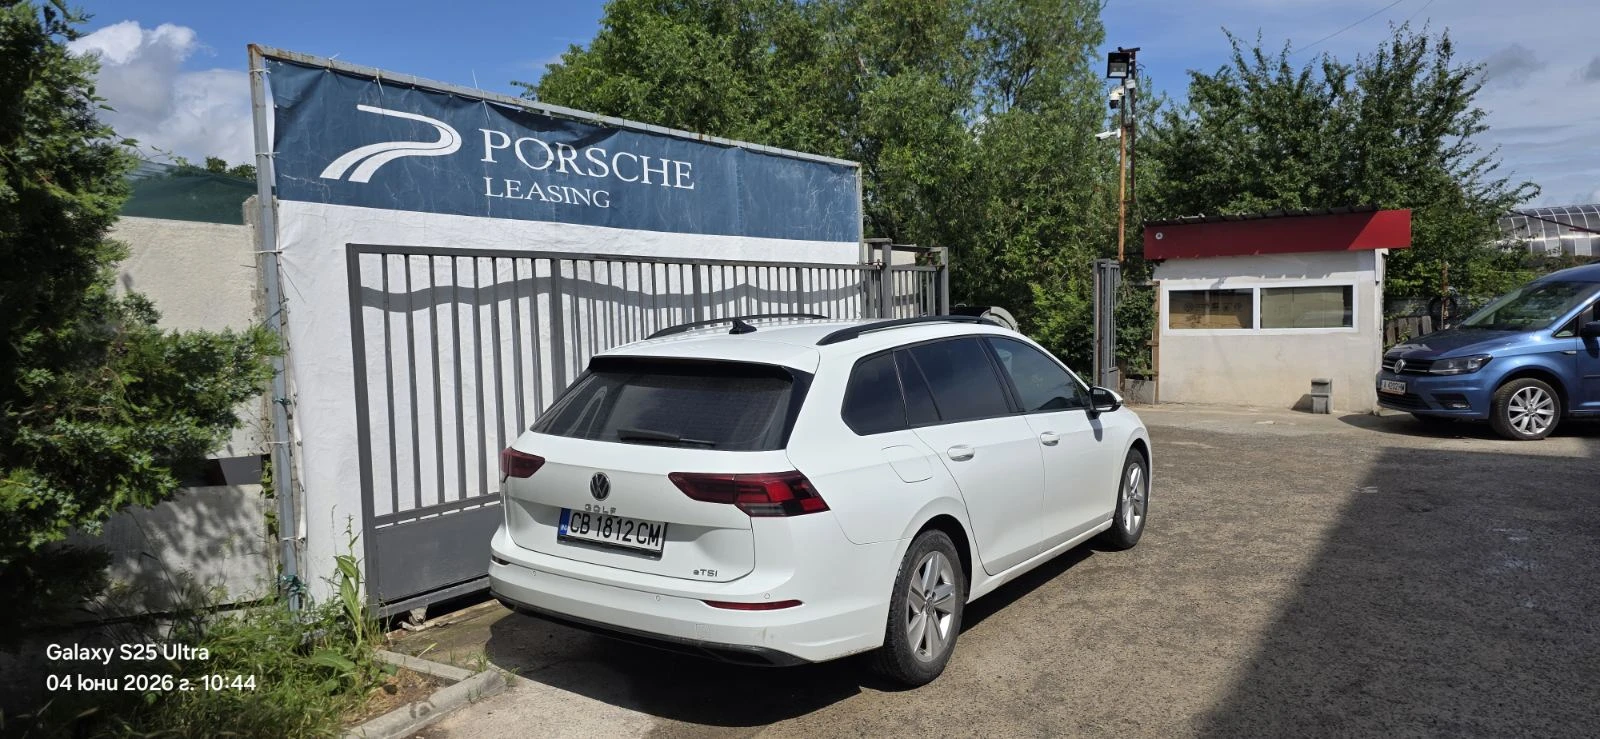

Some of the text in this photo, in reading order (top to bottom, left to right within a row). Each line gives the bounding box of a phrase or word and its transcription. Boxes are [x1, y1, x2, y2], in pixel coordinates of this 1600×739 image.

[478, 128, 695, 190] PORSCHE
[483, 176, 611, 208] LEASING
[584, 504, 617, 514] GOLF
[570, 512, 662, 547] CB 1812 CM
